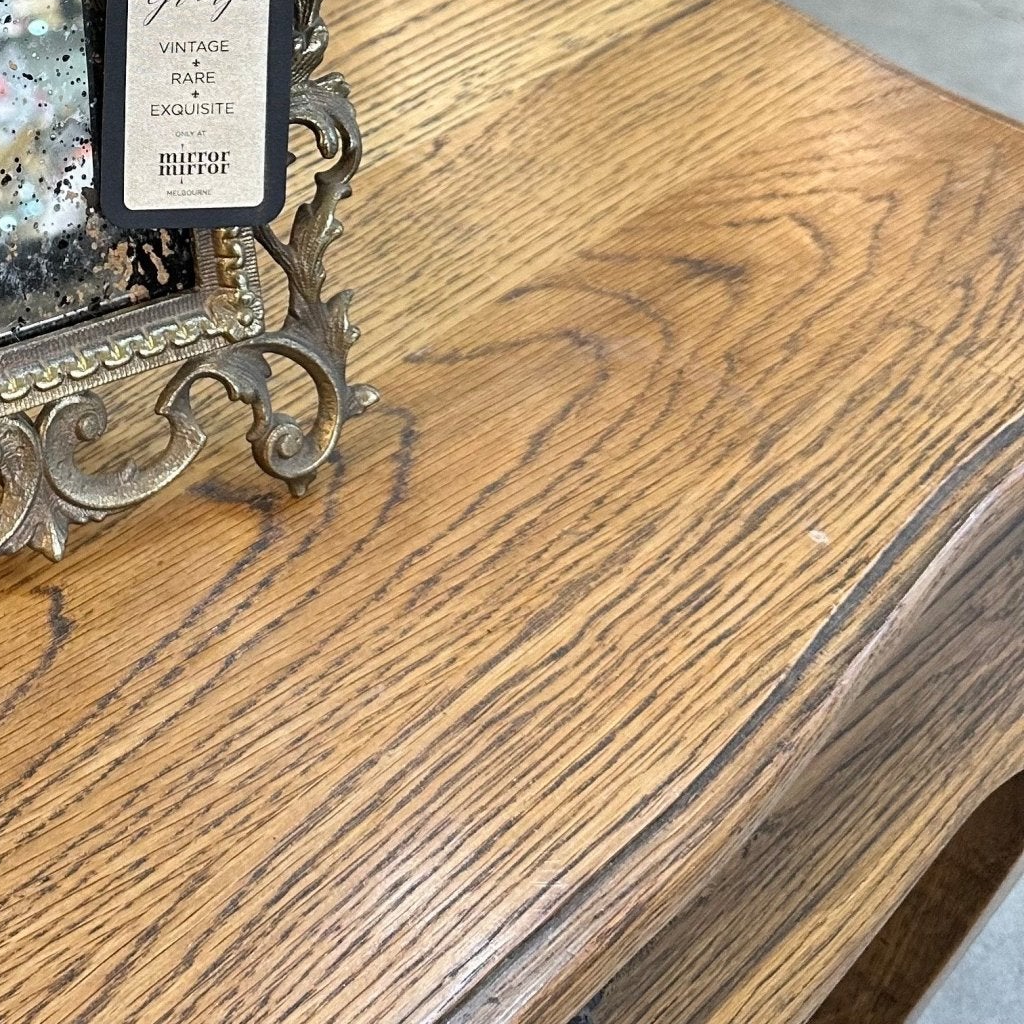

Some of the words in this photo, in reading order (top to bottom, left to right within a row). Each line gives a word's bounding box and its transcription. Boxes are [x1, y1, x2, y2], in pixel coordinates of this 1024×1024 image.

[159, 40, 229, 54] VINTAGE
[171, 72, 216, 85] RARE
[150, 102, 235, 117] EXQUISITE
[159, 144, 230, 165] mirror
[159, 163, 230, 184] mirror
[166, 189, 212, 197] MELBOURNE
